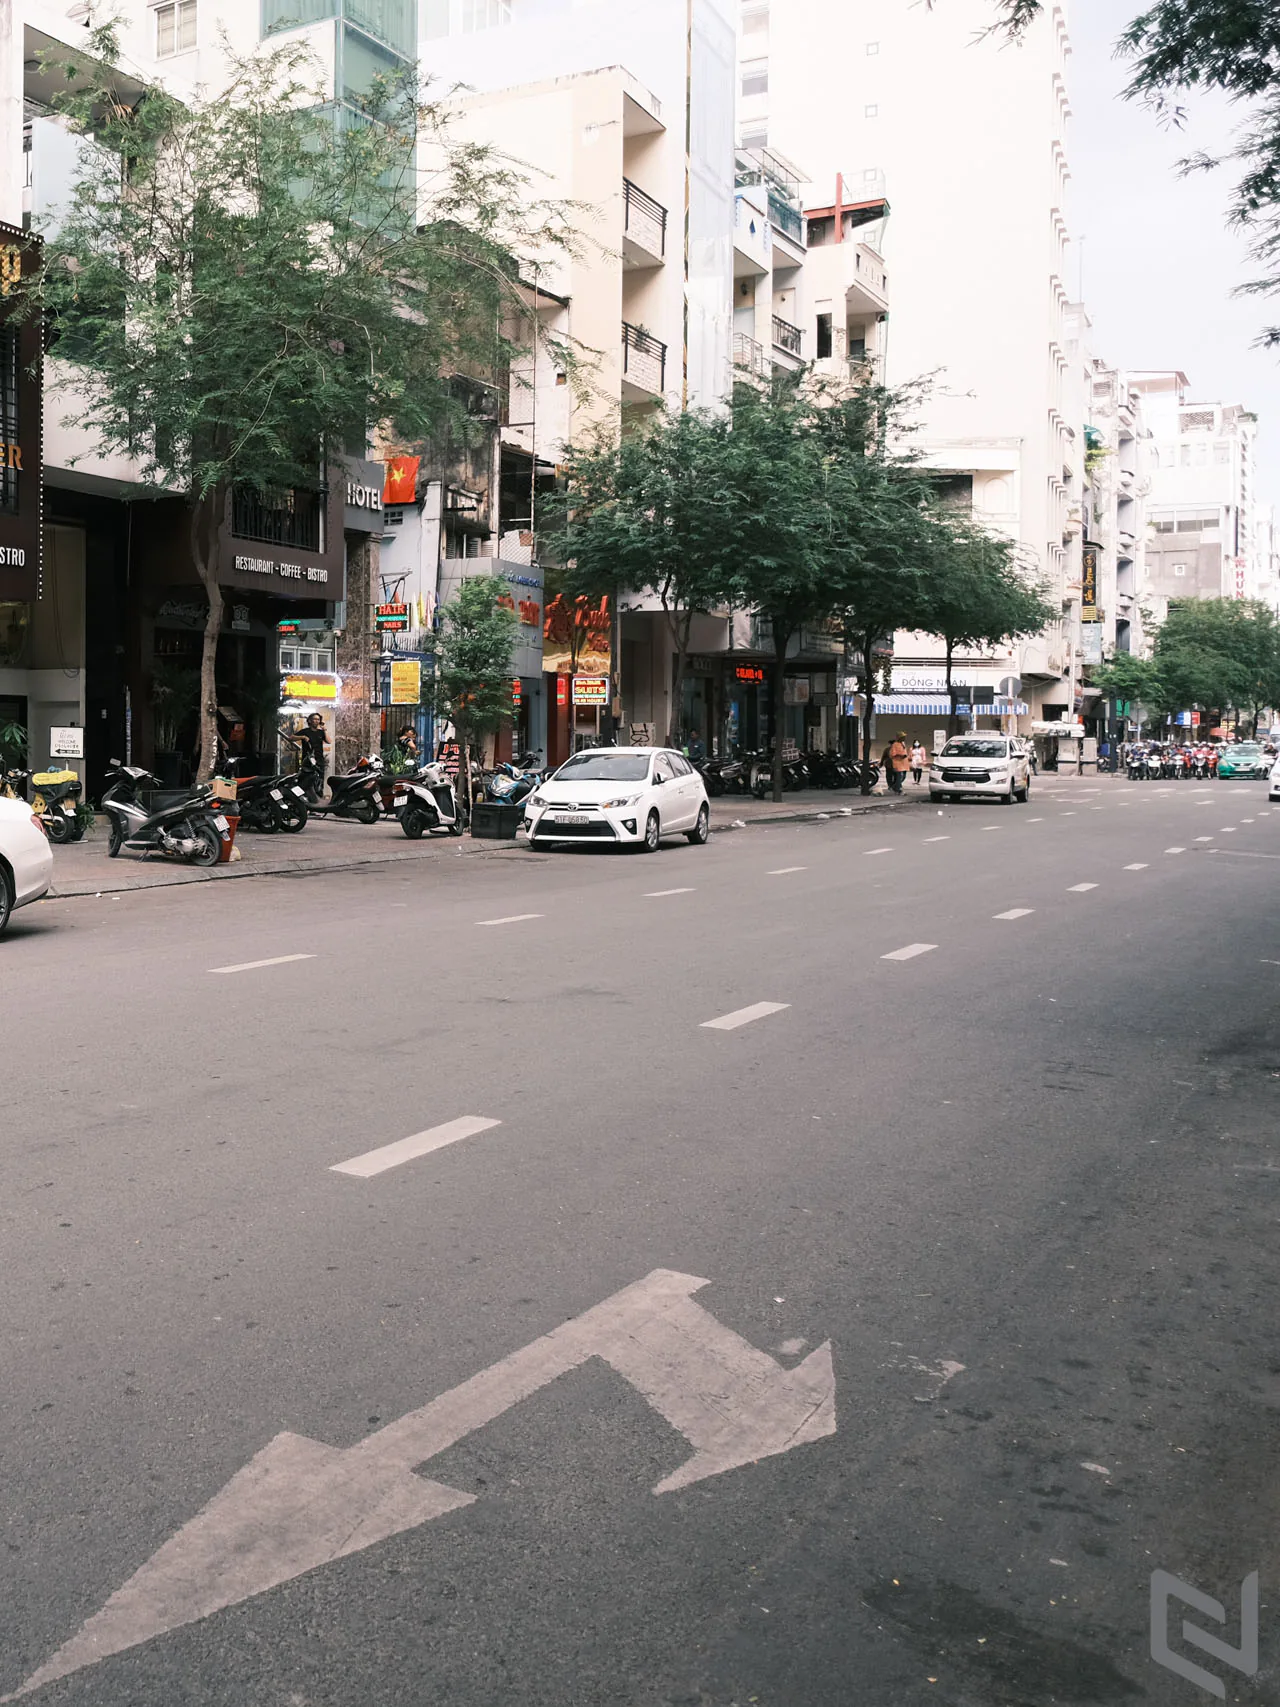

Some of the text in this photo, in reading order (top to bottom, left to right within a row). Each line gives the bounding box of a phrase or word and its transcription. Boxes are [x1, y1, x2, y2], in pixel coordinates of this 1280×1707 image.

[347, 482, 383, 510] HOTEL
[235, 555, 274, 575] RESTAURANT
[280, 562, 301, 579] COFFEE
[307, 567, 328, 583] BISTRO
[378, 604, 405, 615] HAIR
[383, 621, 402, 629] NAILS
